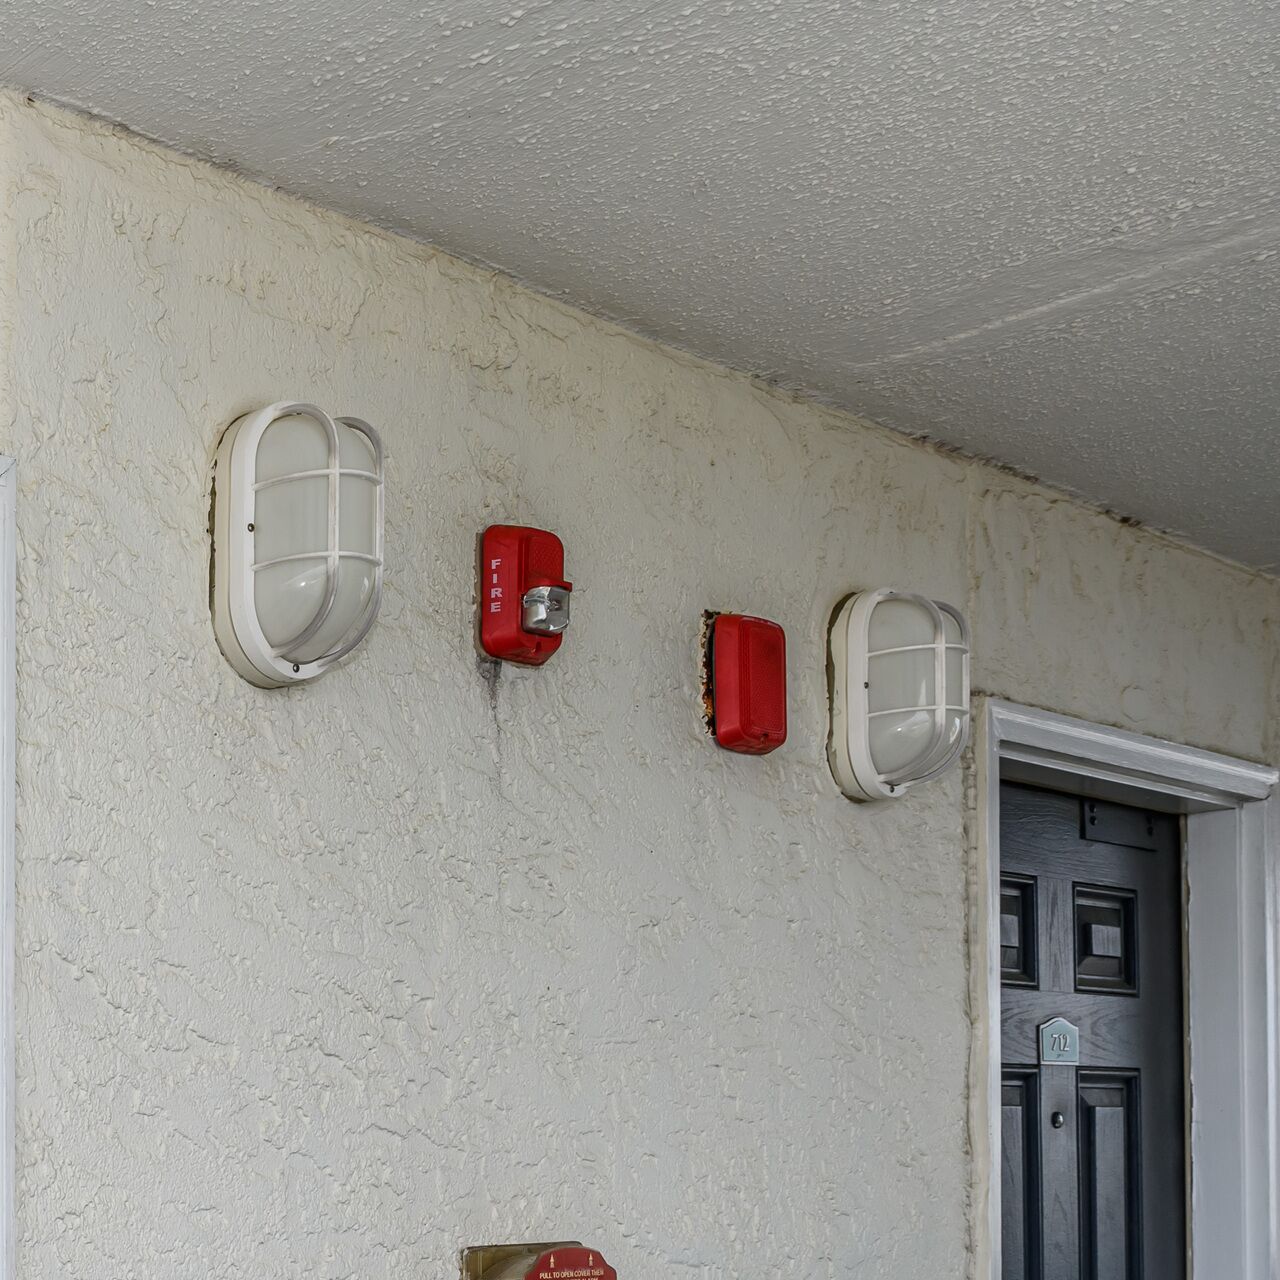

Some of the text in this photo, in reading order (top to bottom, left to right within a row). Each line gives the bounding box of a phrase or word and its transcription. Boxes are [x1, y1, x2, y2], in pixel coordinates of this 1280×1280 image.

[491, 559, 502, 612] FIRE
[1051, 1033, 1070, 1051] 712
[574, 1270, 591, 1278] COVER
[591, 1269, 603, 1277] THEN
